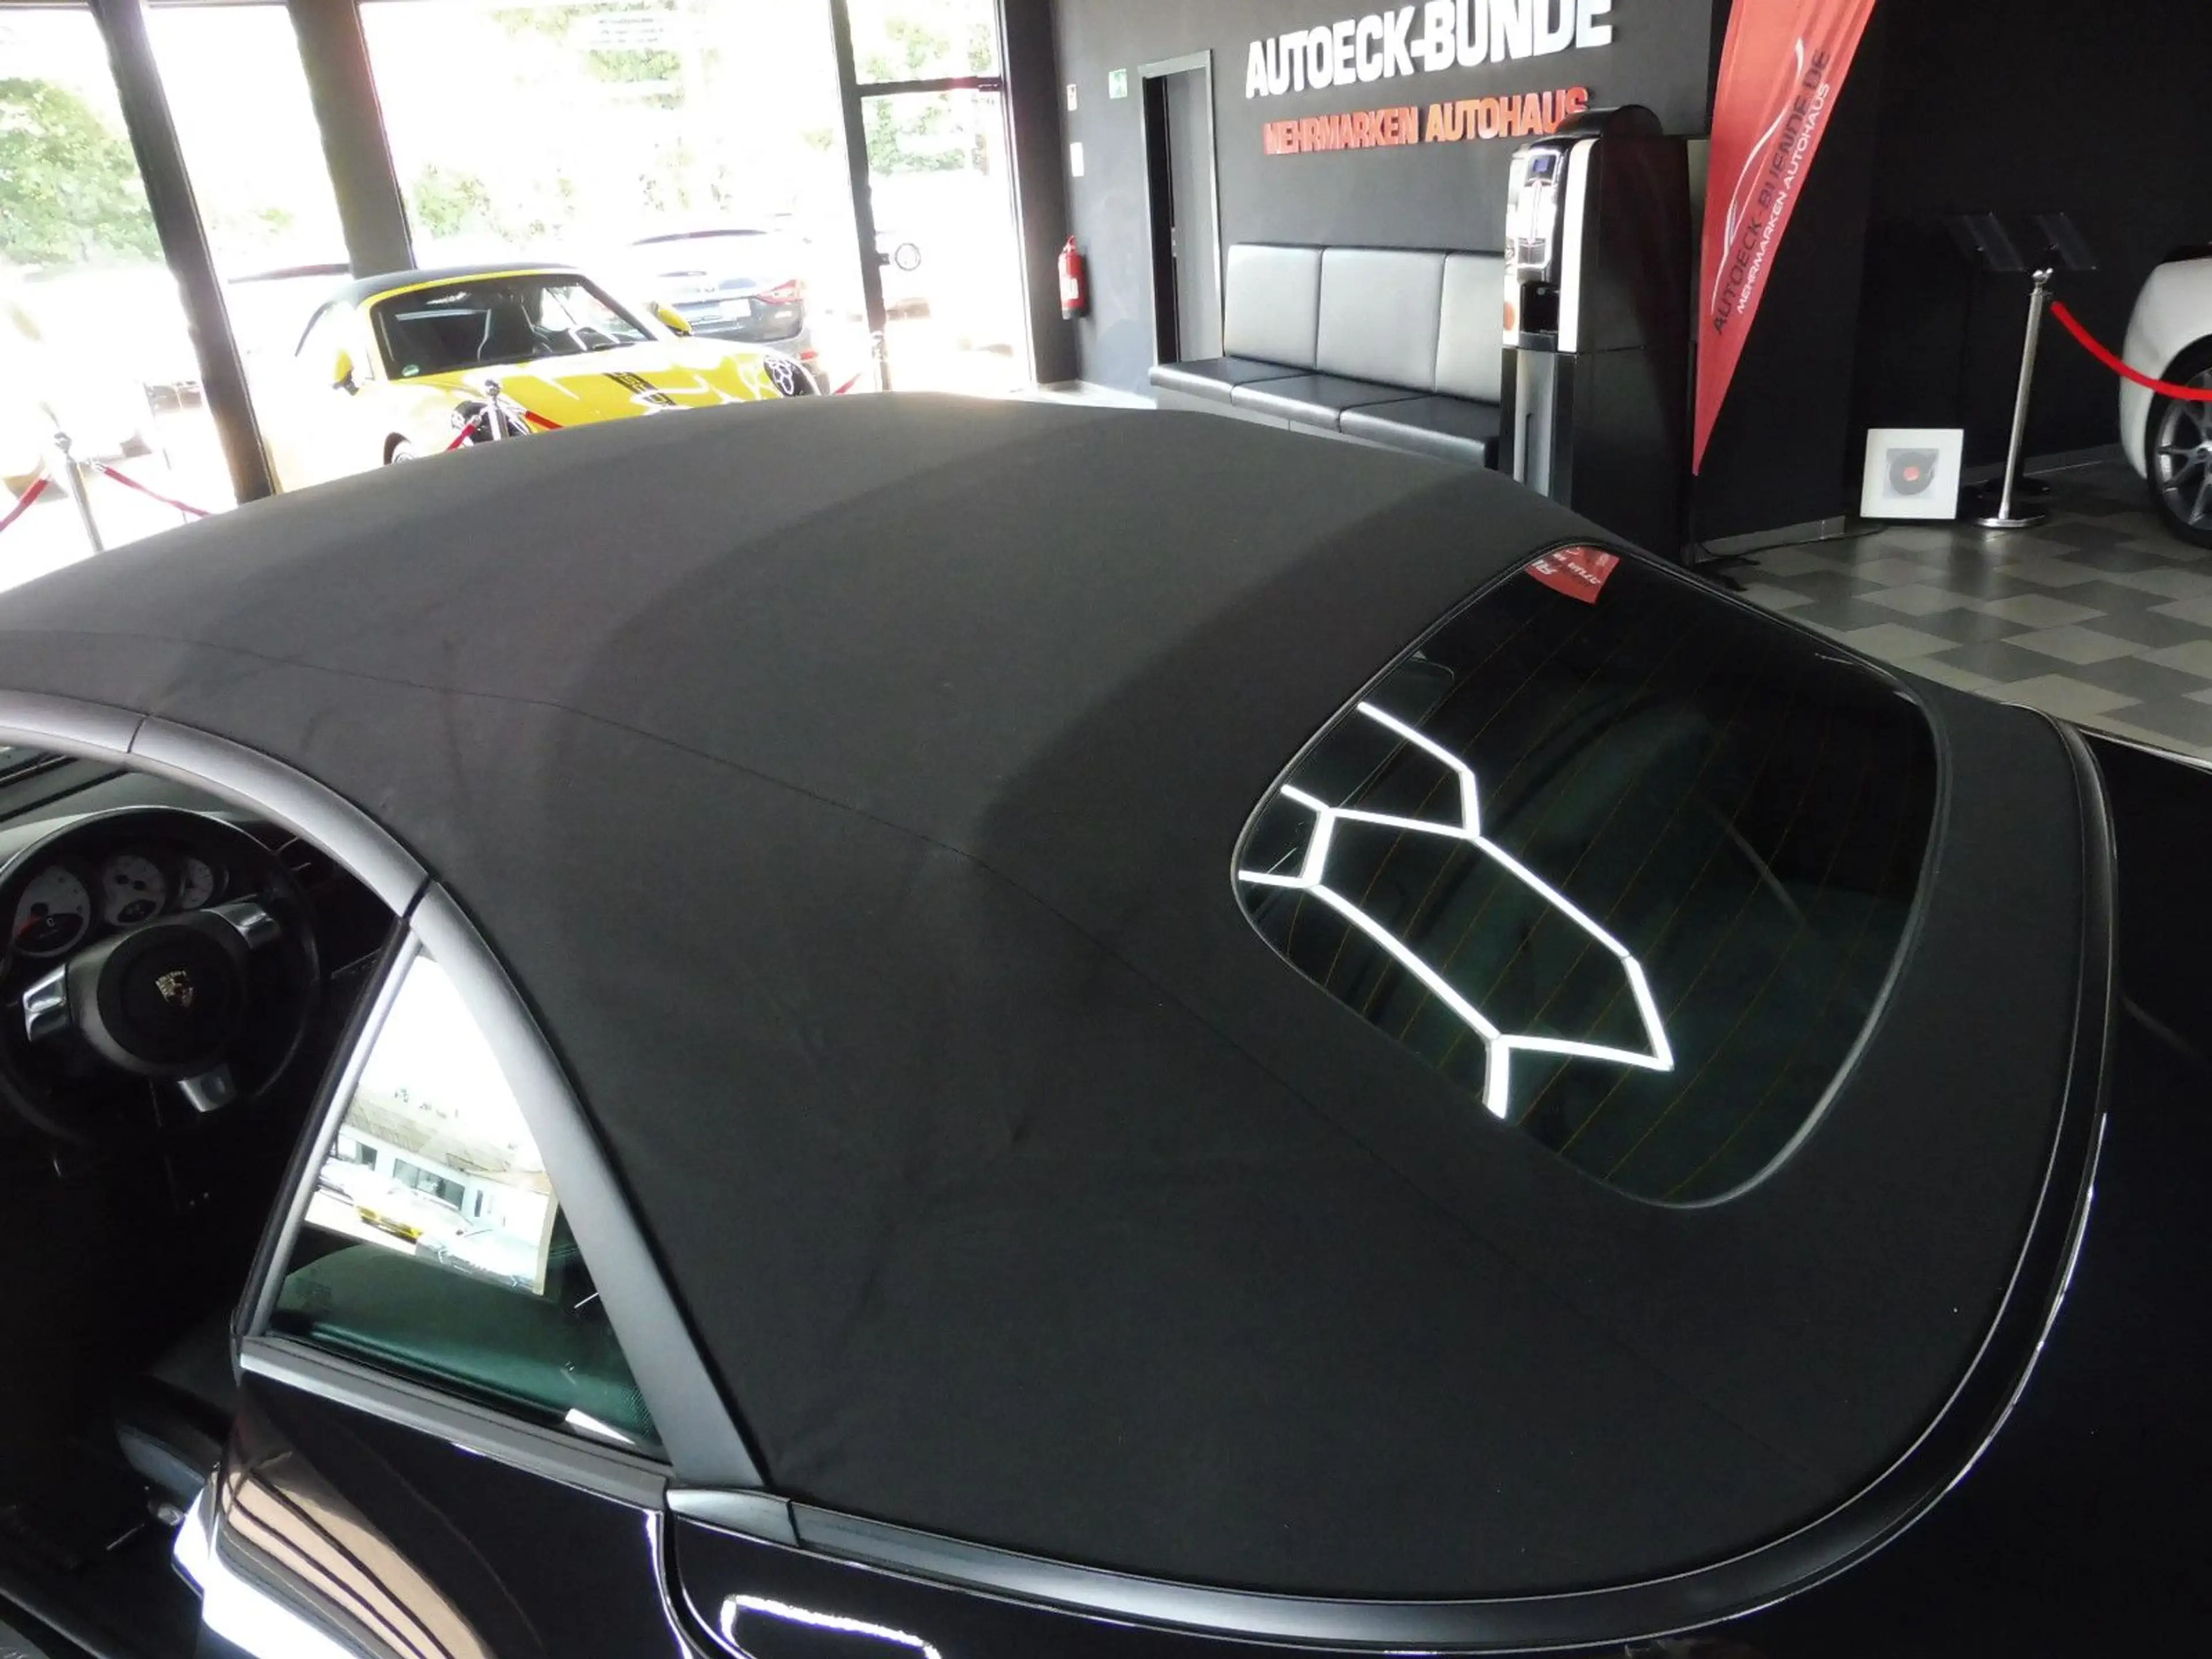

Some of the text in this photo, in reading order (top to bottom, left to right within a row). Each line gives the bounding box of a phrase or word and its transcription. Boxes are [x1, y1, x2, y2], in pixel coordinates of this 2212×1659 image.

[1264, 106, 1418, 154] MEHRMARKEN
[1737, 83, 1830, 314] MEHRMARKEN AUTOHAUS
